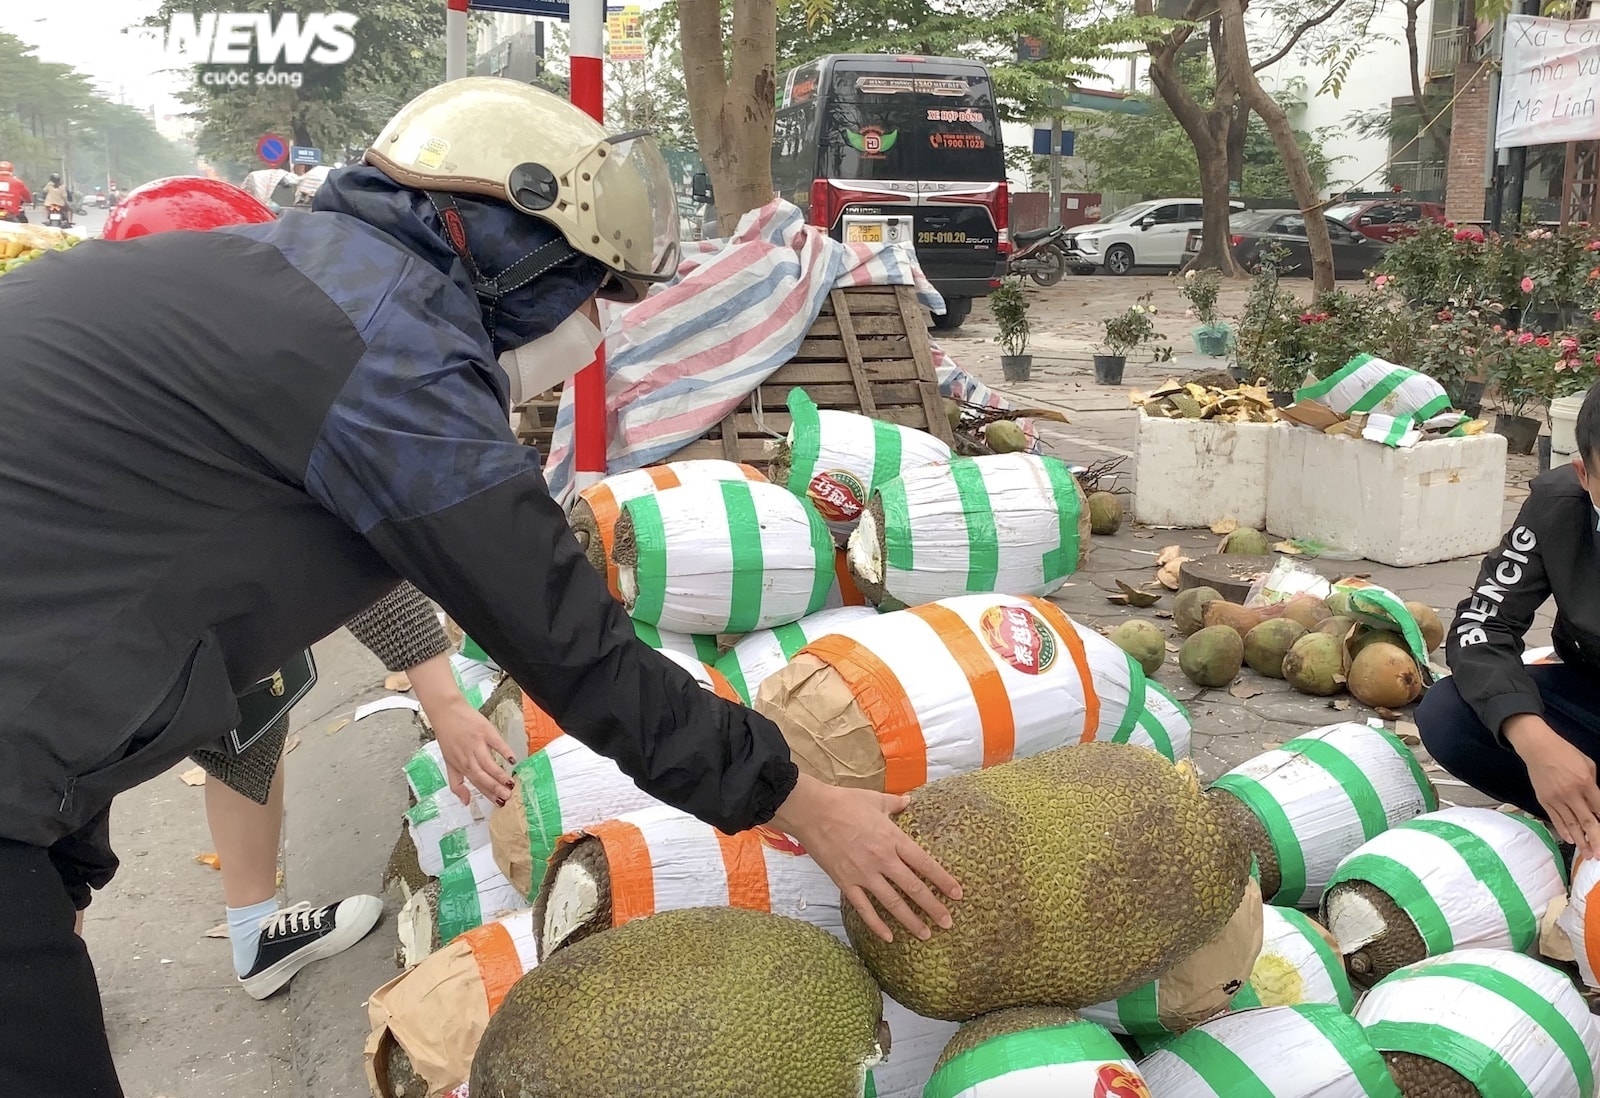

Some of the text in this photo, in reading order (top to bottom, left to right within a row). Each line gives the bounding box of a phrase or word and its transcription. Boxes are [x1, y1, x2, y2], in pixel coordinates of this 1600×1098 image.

[1512, 87, 1595, 124] Mê Linh
[927, 110, 940, 120] XE
[943, 139, 985, 148] 1900.1028
[852, 234, 880, 242] 010.20
[918, 231, 966, 244] 29F-010.20
